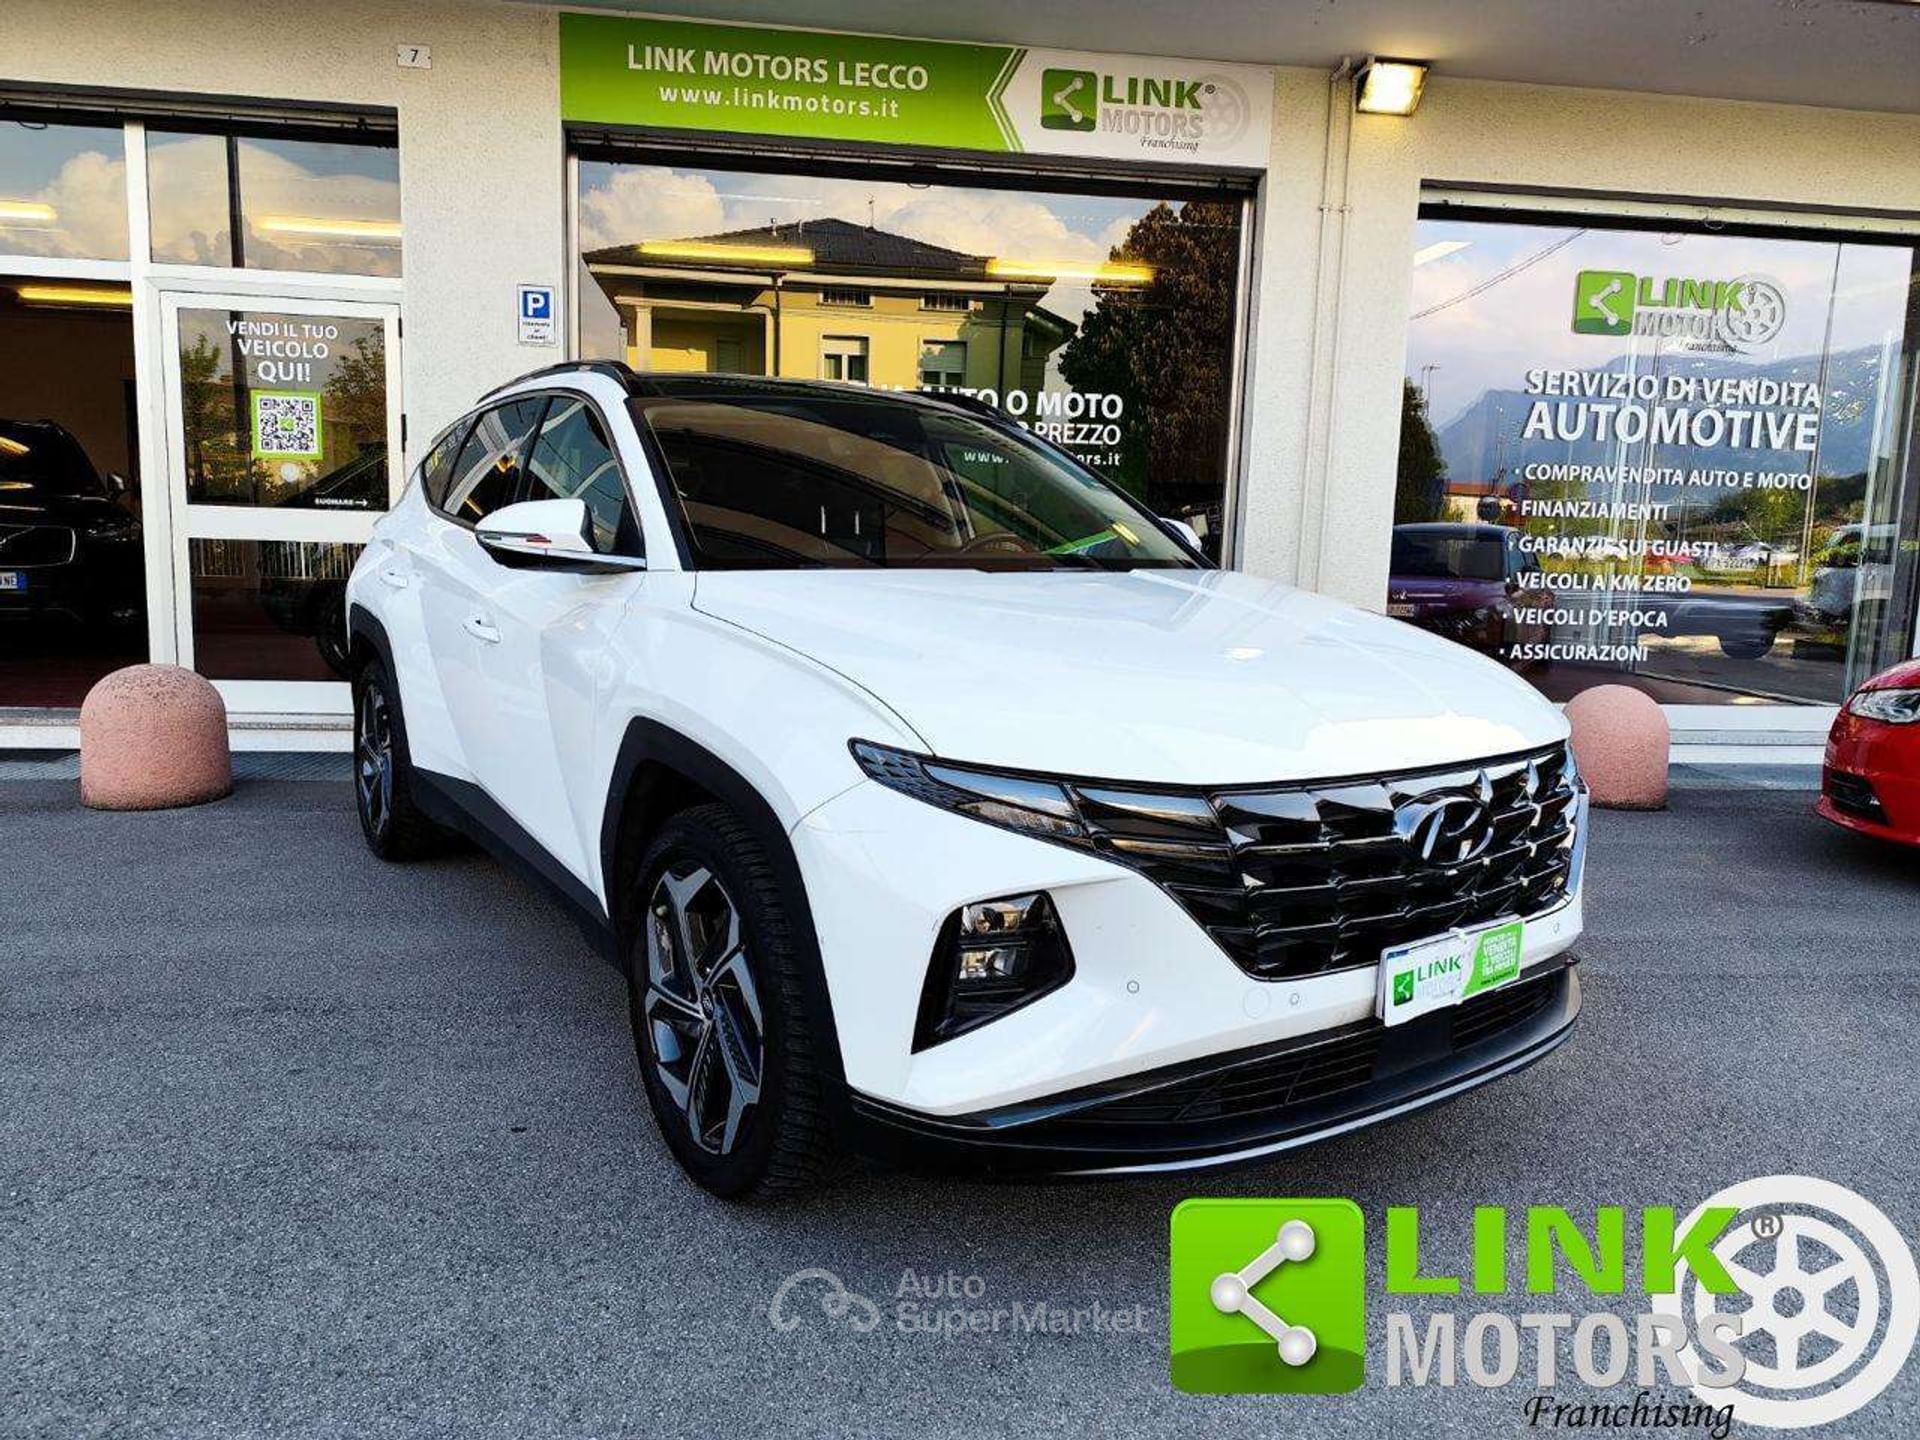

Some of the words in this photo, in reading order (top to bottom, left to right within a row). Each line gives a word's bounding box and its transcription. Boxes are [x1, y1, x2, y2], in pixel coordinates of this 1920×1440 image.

[410, 48, 419, 63] 7
[628, 44, 696, 74] LINK
[703, 50, 828, 84] MOTORS
[838, 61, 929, 91] LECCO
[659, 85, 899, 118] www.linkmotors.it
[1102, 75, 1203, 110] LINK
[1101, 108, 1203, 140] MOTORS
[527, 293, 546, 317] P
[1637, 276, 1747, 313] LINK
[225, 320, 280, 336] VENDI
[283, 323, 299, 338] IL
[301, 324, 339, 339] TUO
[237, 338, 329, 359] VEICOLO
[257, 360, 311, 383] QUI!
[1525, 369, 1660, 400] SERVIZIO
[1666, 377, 1696, 402] DI
[1699, 377, 1821, 408] VENDITA
[1005, 390, 1029, 416] O
[1035, 391, 1124, 420] MOTO
[1522, 400, 1819, 451] AUTOMOTIVE
[1525, 463, 1684, 487] COMPRAVENDITA
[1688, 469, 1739, 488] AUTO
[1743, 471, 1753, 489] E
[1757, 472, 1812, 491] MOTO
[1520, 500, 1669, 522] FINANZIAMENTI
[1651, 540, 1719, 559] GUASTI
[1516, 571, 1589, 591] VEICOLI
[1592, 574, 1606, 591] A
[1609, 574, 1641, 592] KM
[1642, 575, 1692, 593] ZERO
[1513, 607, 1584, 626] VEICOLI
[1588, 609, 1669, 629] D'EPOCA
[1510, 644, 1650, 663] ASSICURAZIONI
[1417, 954, 1462, 982] LINK
